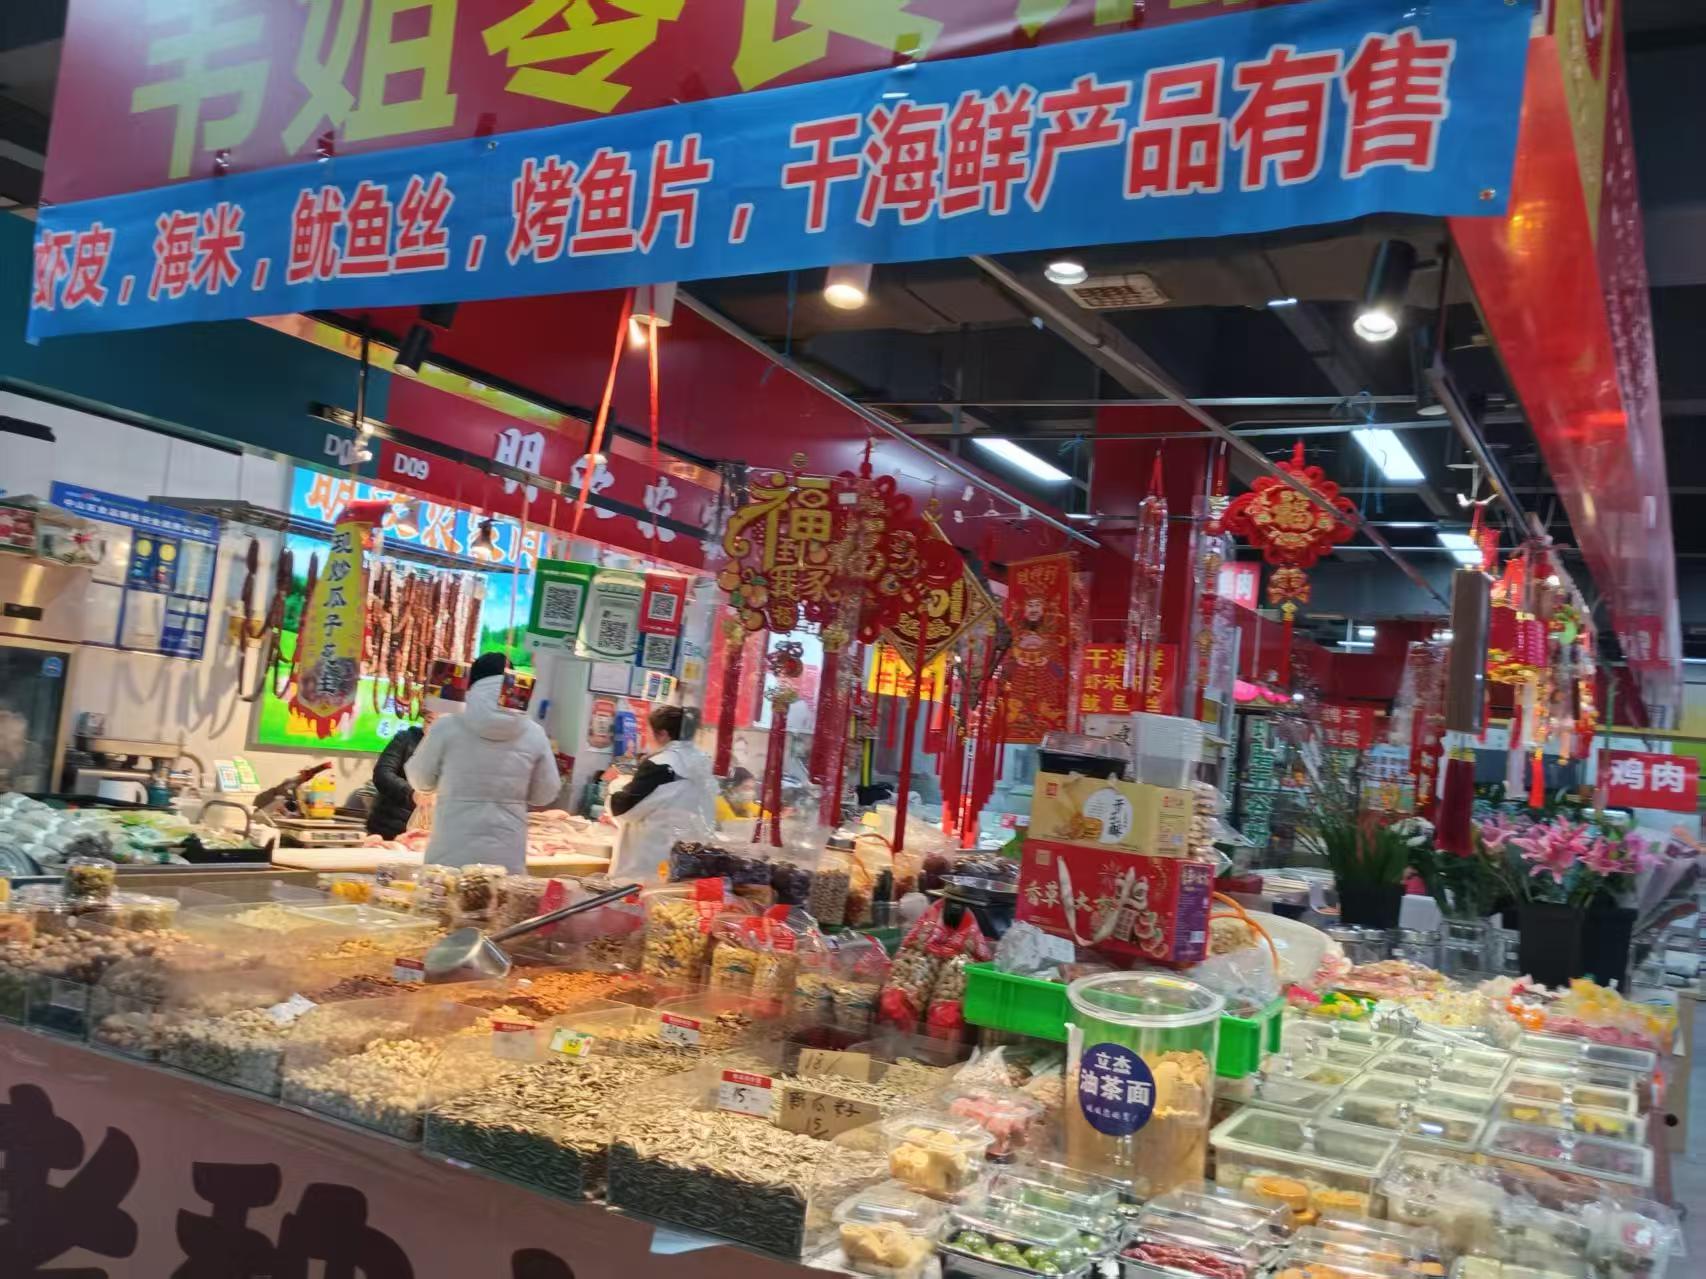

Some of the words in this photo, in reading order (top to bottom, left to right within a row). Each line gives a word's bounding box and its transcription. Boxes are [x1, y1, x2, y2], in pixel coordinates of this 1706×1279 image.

[324, 433, 368, 466] D0
[393, 453, 430, 480] D09
[1610, 758, 1686, 793] 鸡肉
[1080, 1068, 1152, 1106] 油茶面
